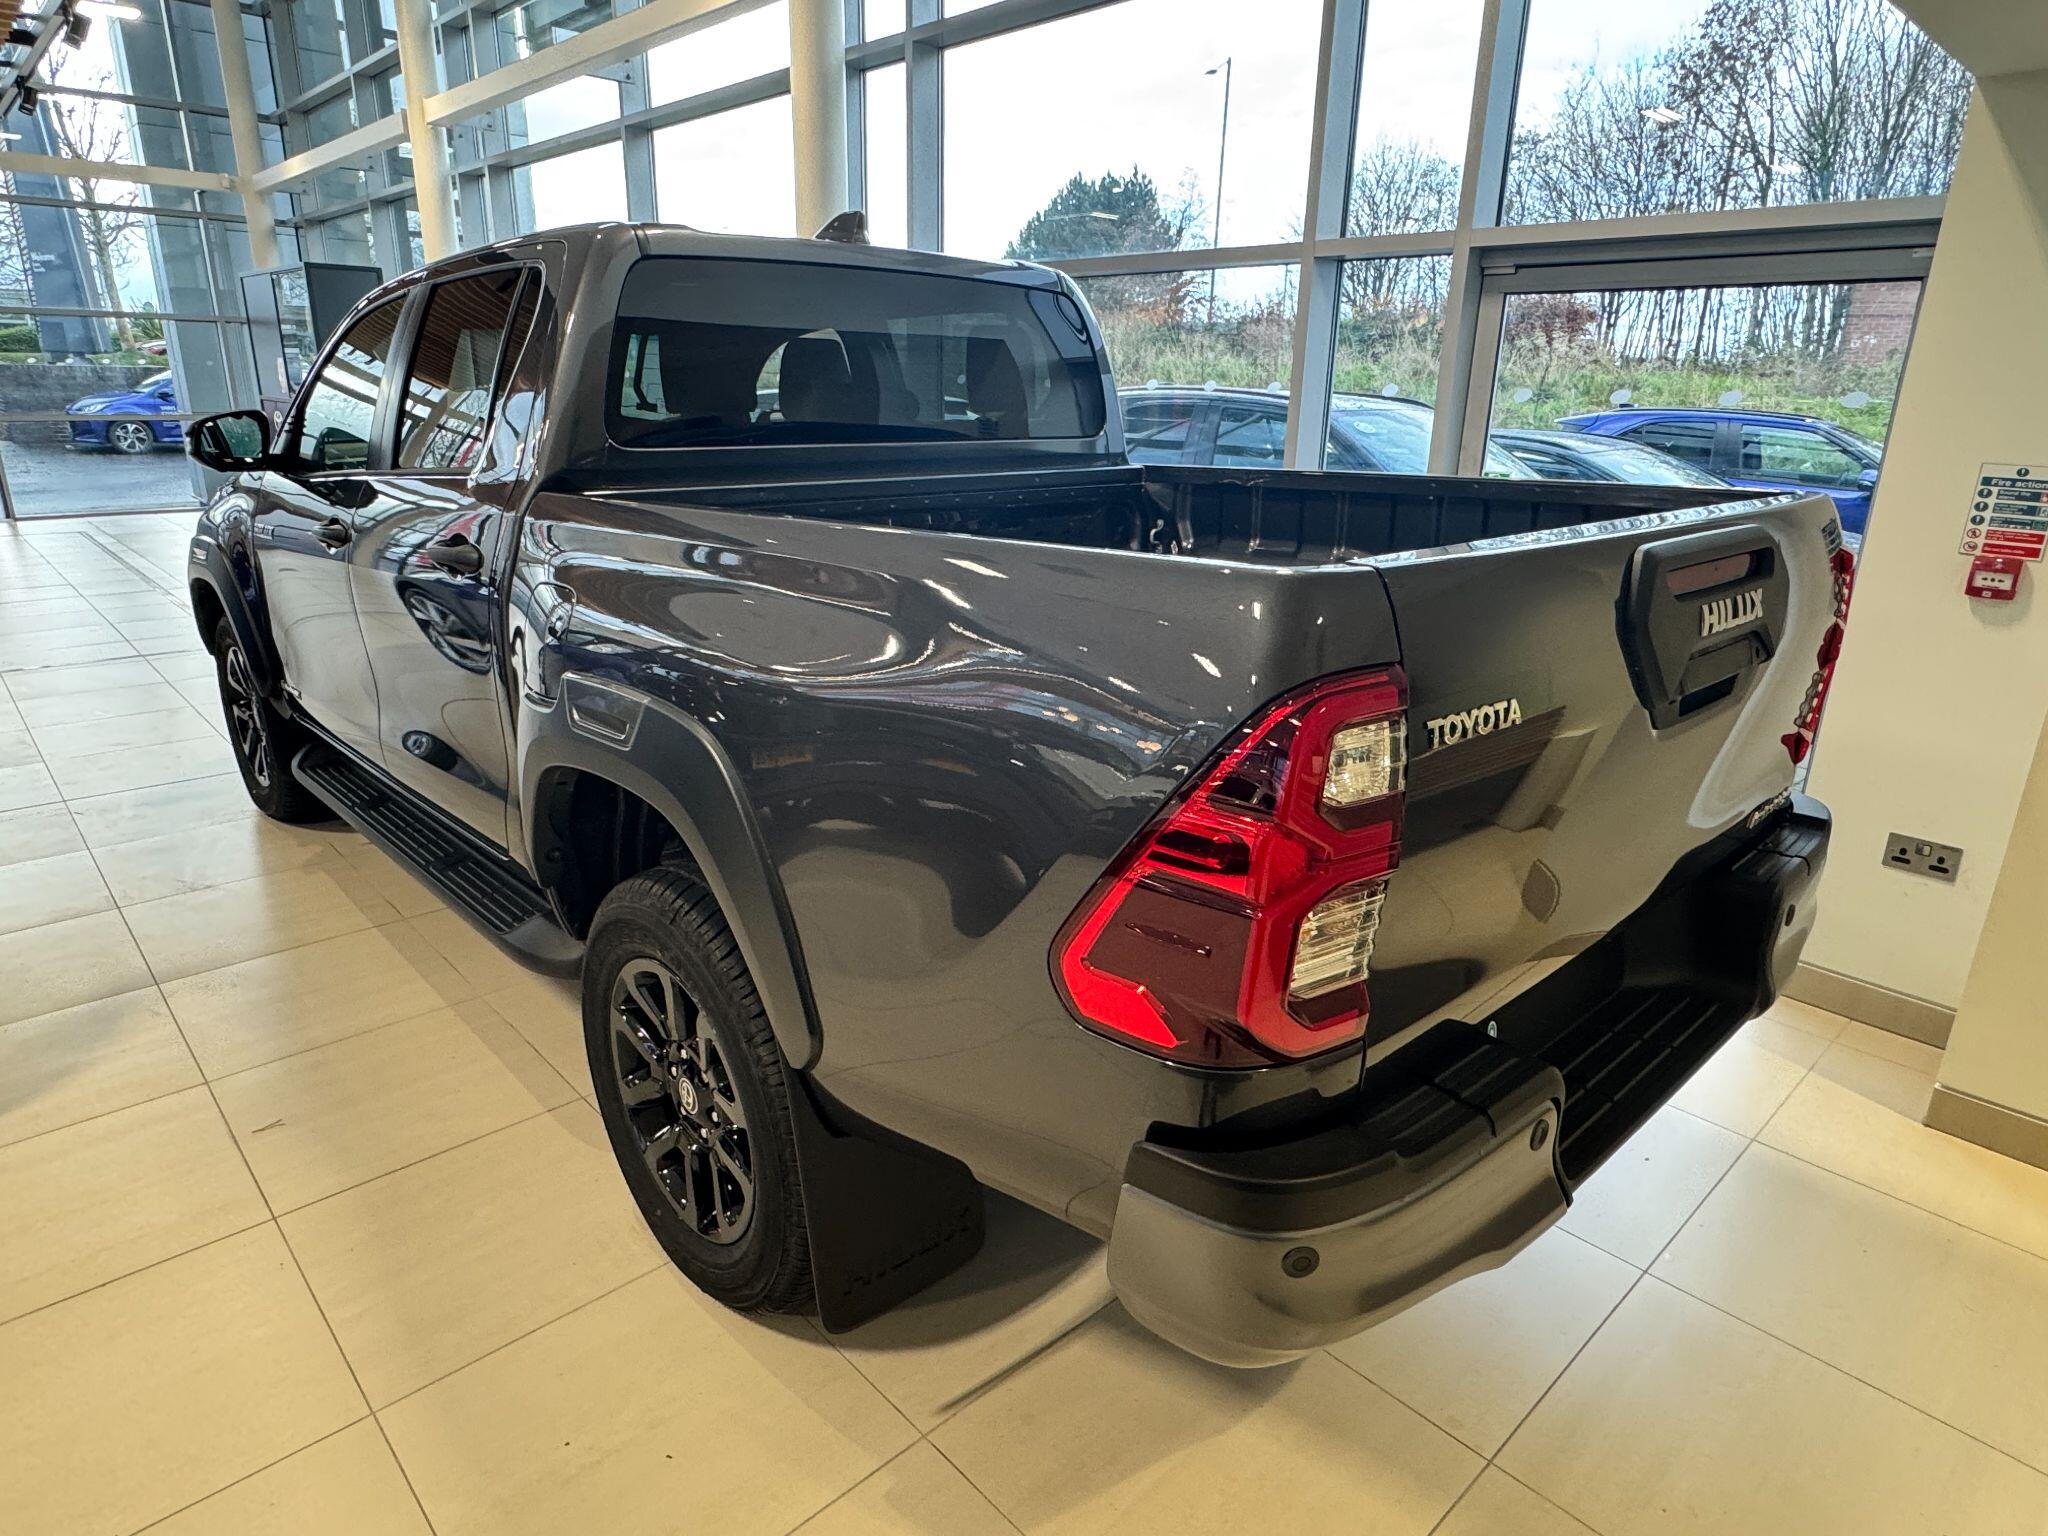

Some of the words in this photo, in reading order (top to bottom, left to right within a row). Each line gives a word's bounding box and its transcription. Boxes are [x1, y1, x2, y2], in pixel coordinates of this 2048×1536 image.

[1991, 478, 2012, 487] Fire
[2014, 481, 2048, 489] action
[1701, 588, 1763, 637] HILUX
[1426, 698, 1522, 749] TOYOTA
